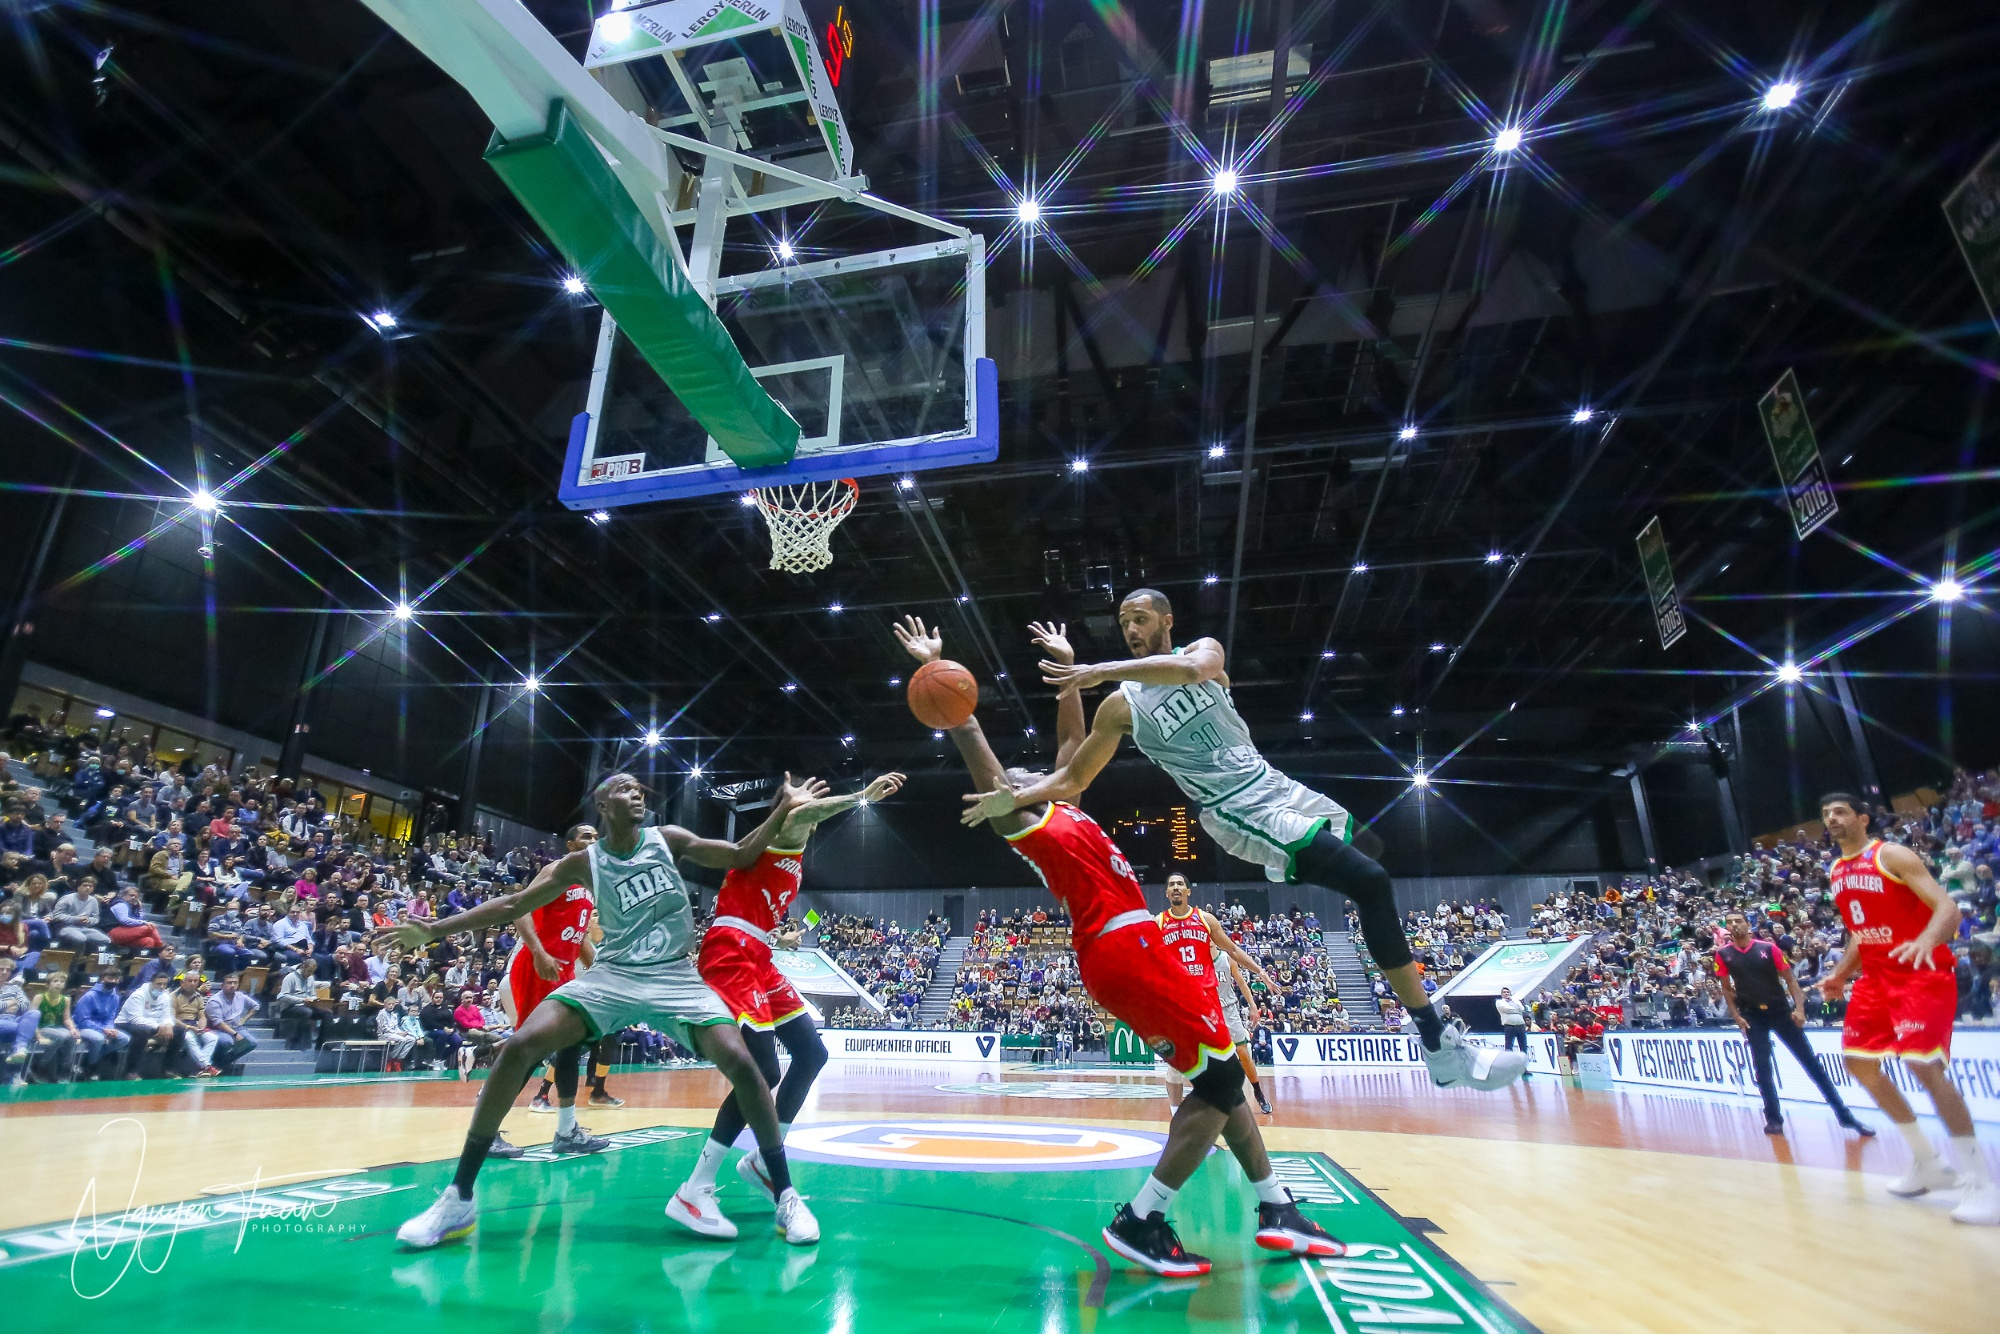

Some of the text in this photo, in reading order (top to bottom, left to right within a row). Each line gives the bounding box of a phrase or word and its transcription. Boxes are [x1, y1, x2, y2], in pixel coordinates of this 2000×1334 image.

[633, 12, 676, 44] MERLIN
[681, 0, 725, 39] LEROY
[785, 14, 805, 36] LEROY
[819, 103, 835, 120] LEROY
[1796, 480, 1828, 523] 2016
[1660, 605, 1681, 638] 2005
[1151, 683, 1217, 743] ADA
[614, 864, 675, 915] ADA
[579, 908, 588, 927] 6
[1849, 899, 1865, 925] 8
[1178, 945, 1196, 962] 13
[845, 1038, 952, 1054] EQUIPEMENTIER OFFICIEL
[1316, 1038, 1403, 1062] VESTIAIRE
[1631, 1038, 1700, 1082] VESTIAIRE
[1698, 1039, 1724, 1084] DU
